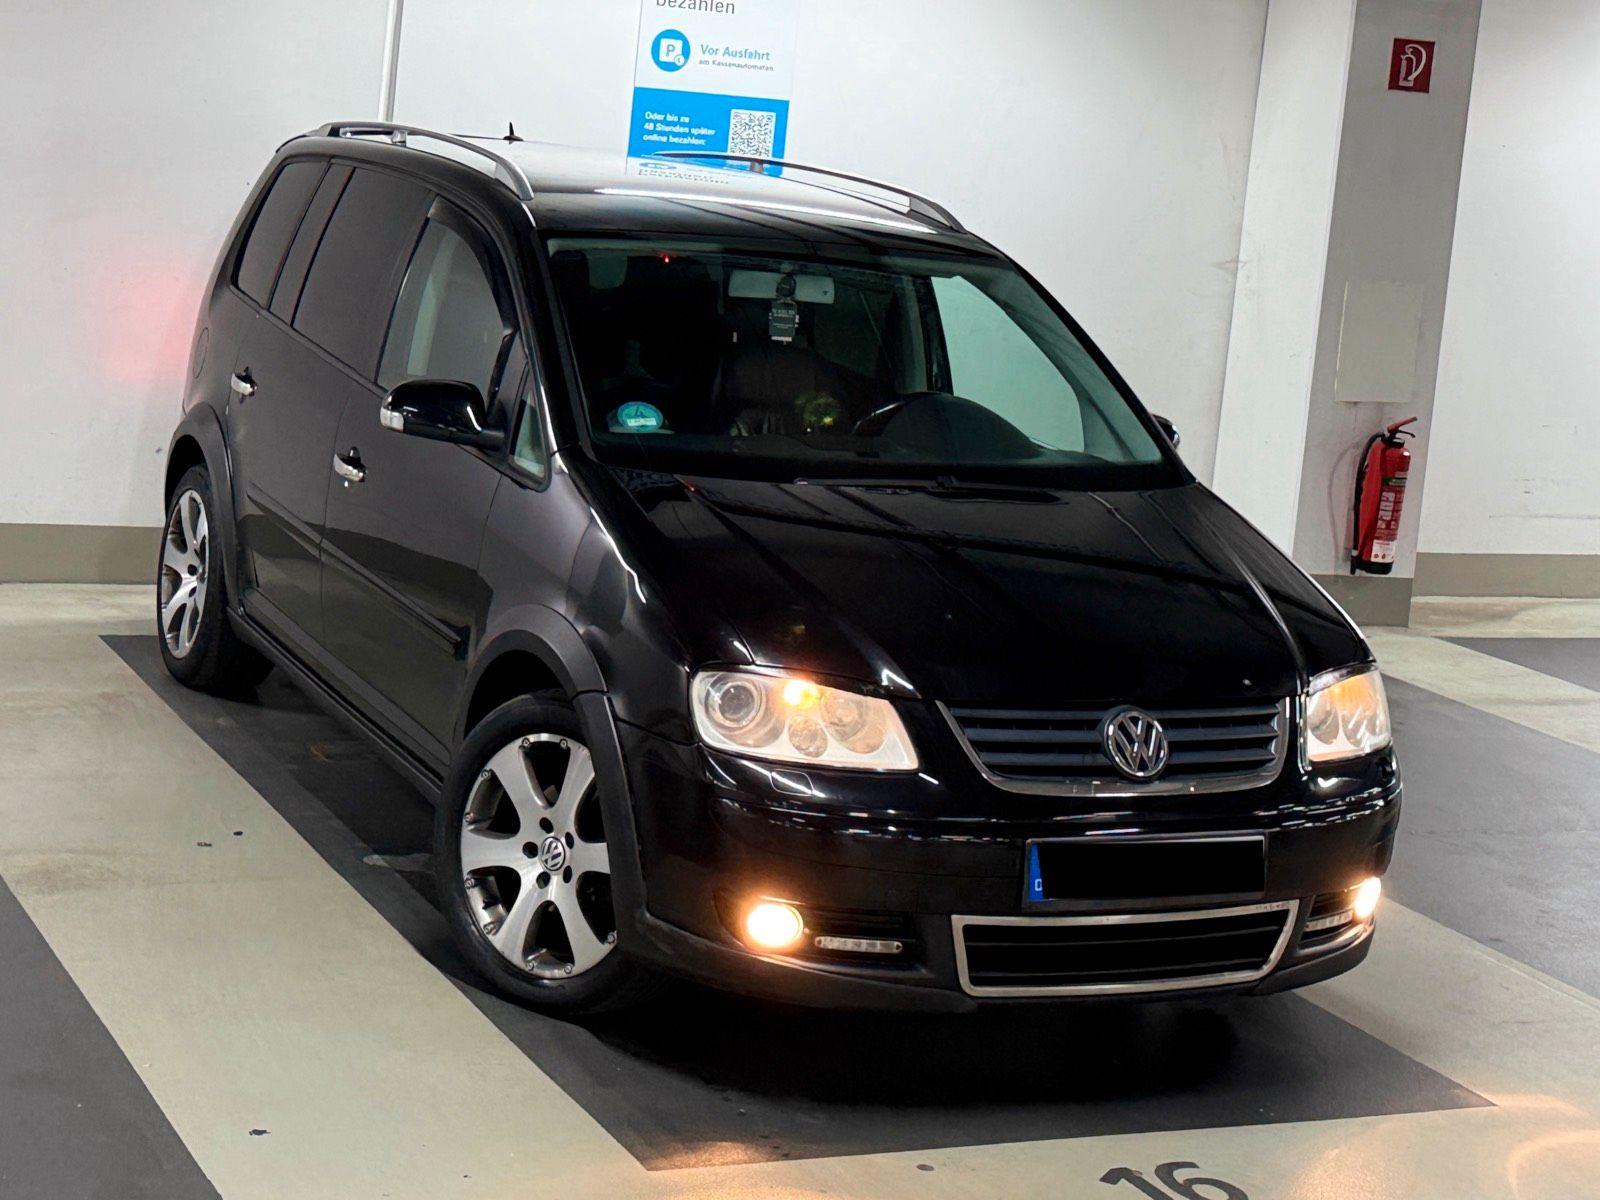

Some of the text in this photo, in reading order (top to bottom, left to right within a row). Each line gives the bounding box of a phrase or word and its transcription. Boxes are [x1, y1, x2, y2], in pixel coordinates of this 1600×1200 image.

[666, 44, 676, 56] P
[700, 44, 770, 60] Vor Ausfahrt
[712, 60, 774, 71] Kassenautomaten
[644, 111, 665, 120] Oder
[666, 113, 678, 122] bis
[643, 122, 716, 136] 48 Stunden später
[642, 133, 668, 142] online
[1104, 711, 1167, 777] VW
[1099, 1161, 1249, 1200] 16
